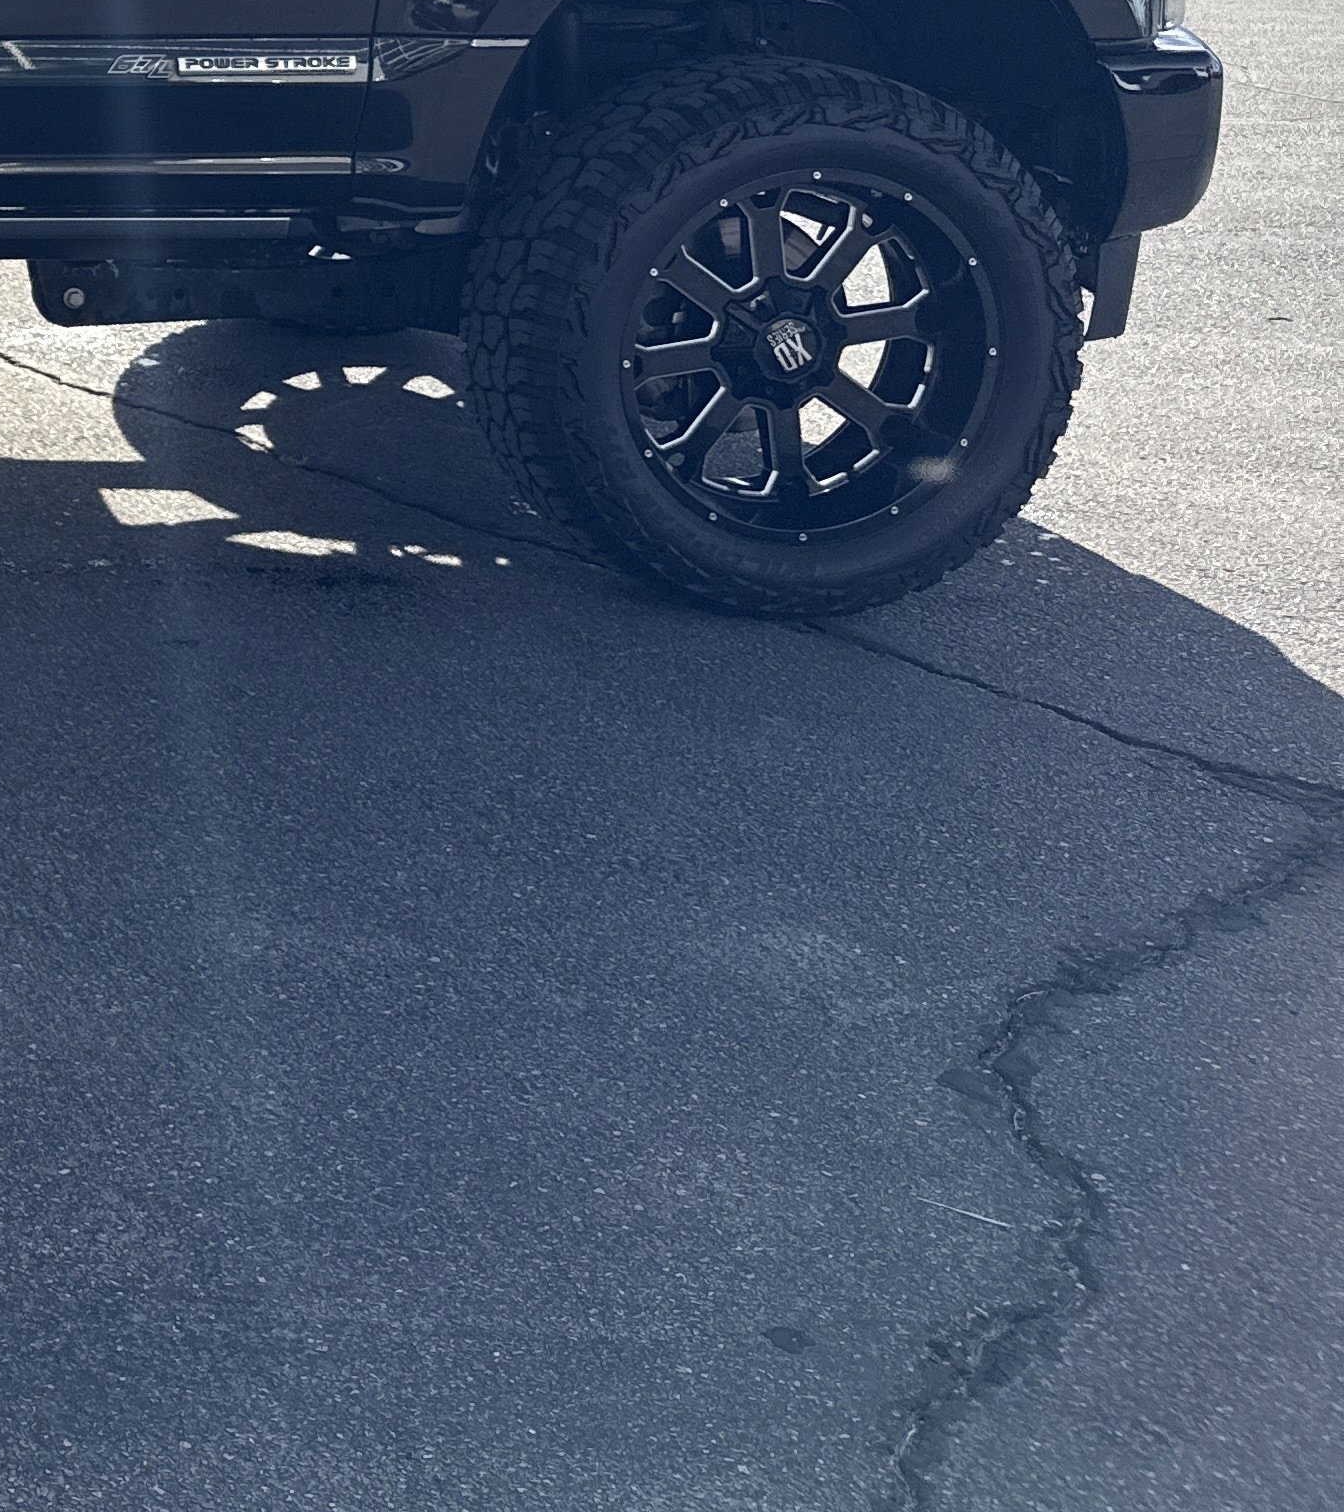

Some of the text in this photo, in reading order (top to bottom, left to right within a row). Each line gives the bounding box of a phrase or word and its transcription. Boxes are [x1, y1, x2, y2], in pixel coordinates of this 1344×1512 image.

[185, 56, 351, 70] POWER STROKE
[766, 322, 798, 347] SERIES
[773, 333, 813, 372] XD
